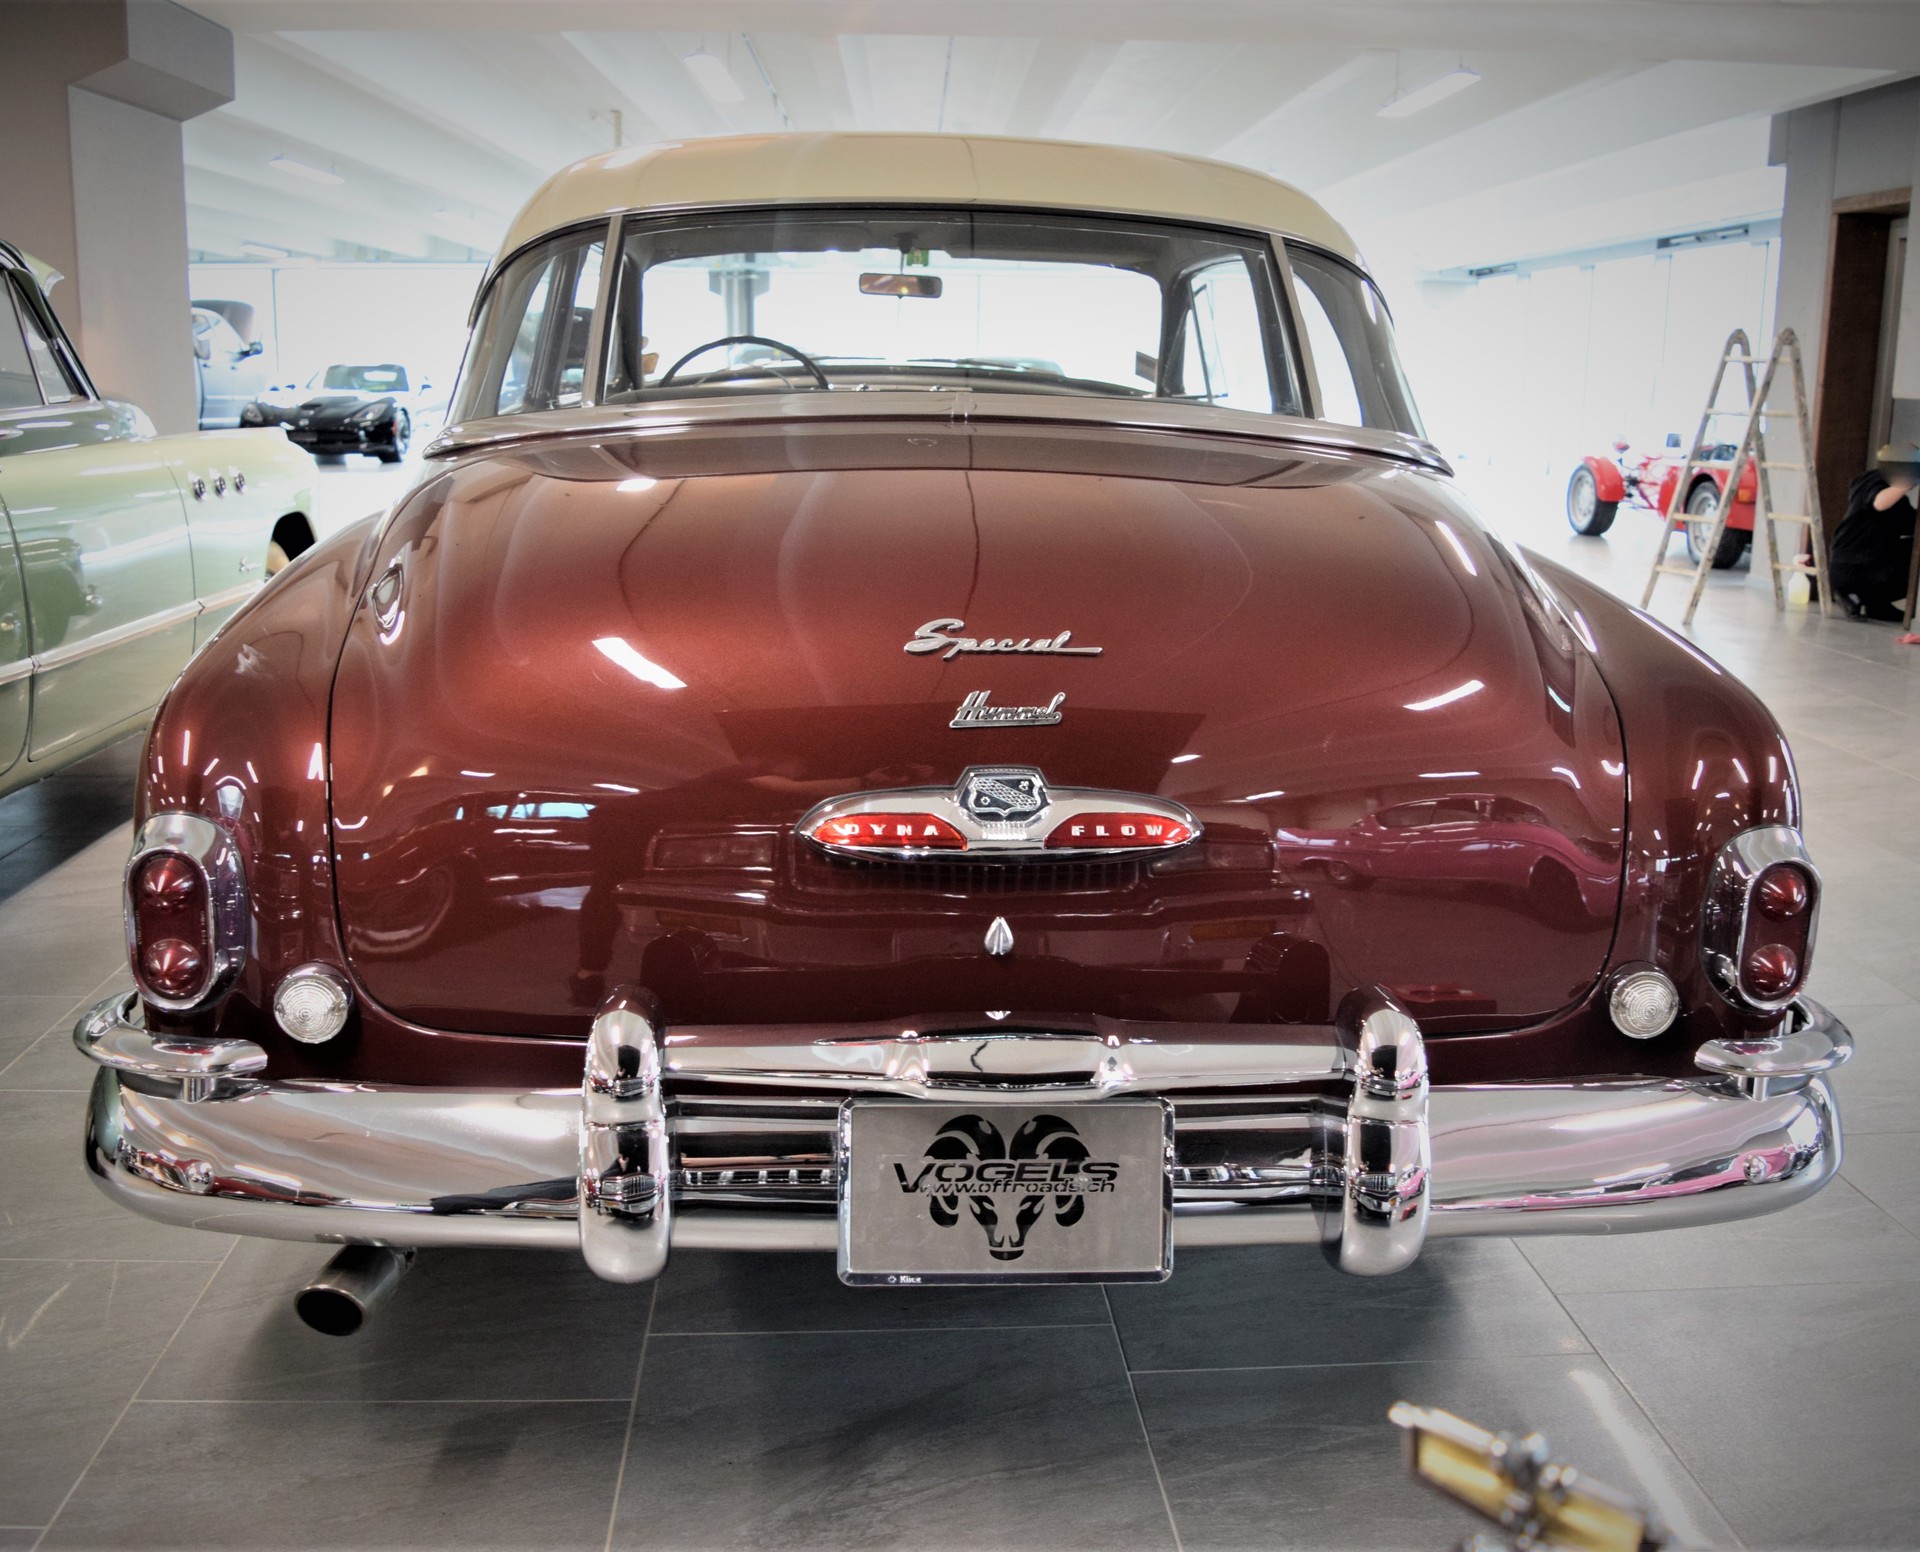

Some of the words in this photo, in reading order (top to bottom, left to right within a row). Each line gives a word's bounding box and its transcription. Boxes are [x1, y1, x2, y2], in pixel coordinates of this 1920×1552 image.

[903, 618, 1103, 661] Special
[950, 690, 1066, 728] Hummel
[843, 823, 939, 836] DYNA
[1071, 825, 1163, 836] FLOW
[893, 1162, 1120, 1193] VOGELS
[918, 1178, 1115, 1193] www.offroads.ch
